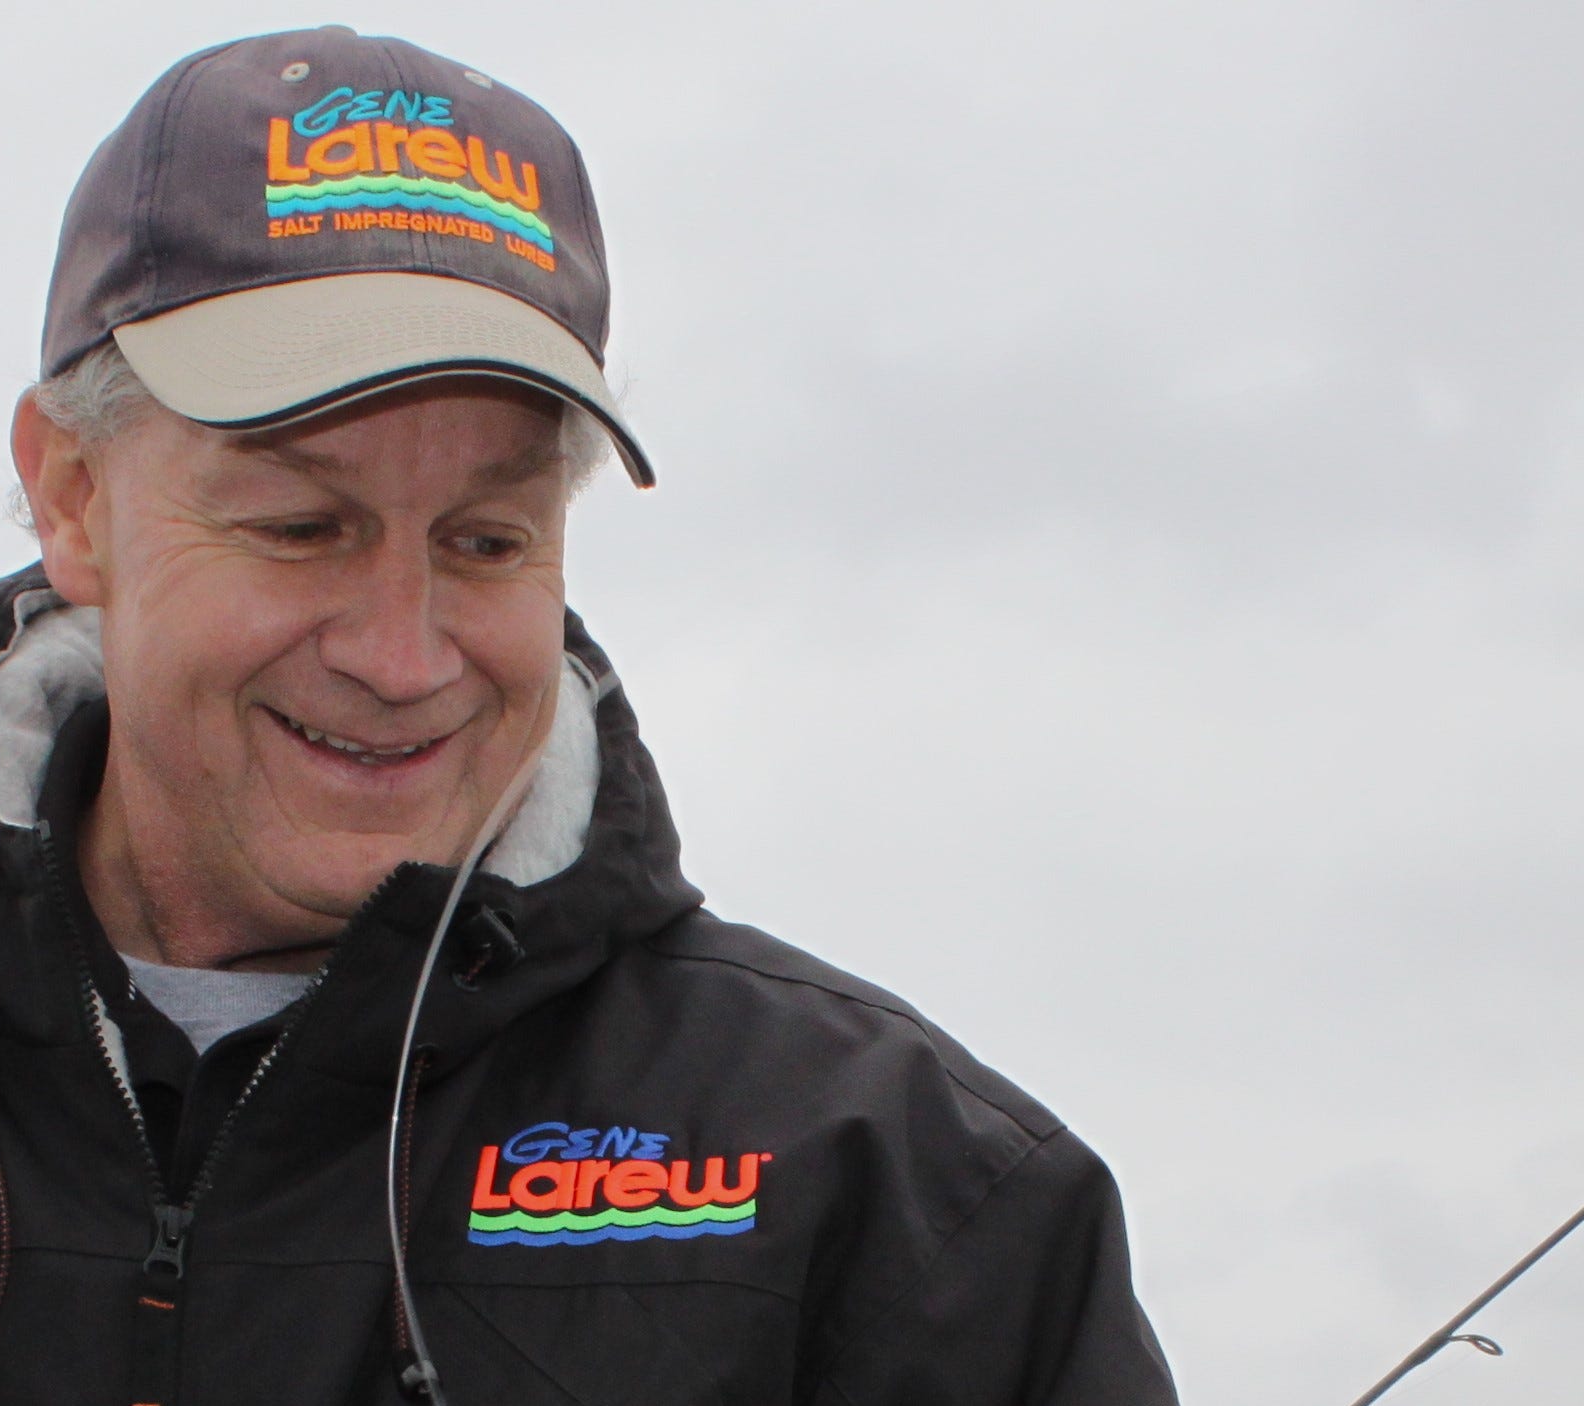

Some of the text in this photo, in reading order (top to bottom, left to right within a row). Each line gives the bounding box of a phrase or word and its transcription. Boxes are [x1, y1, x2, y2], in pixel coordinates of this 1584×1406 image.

[292, 86, 454, 137] GENE
[267, 116, 543, 211] Larew
[268, 214, 324, 239] SALT
[333, 210, 495, 243] IMPREGNATED
[502, 1121, 671, 1164] GENE
[471, 1145, 760, 1211] Larew
